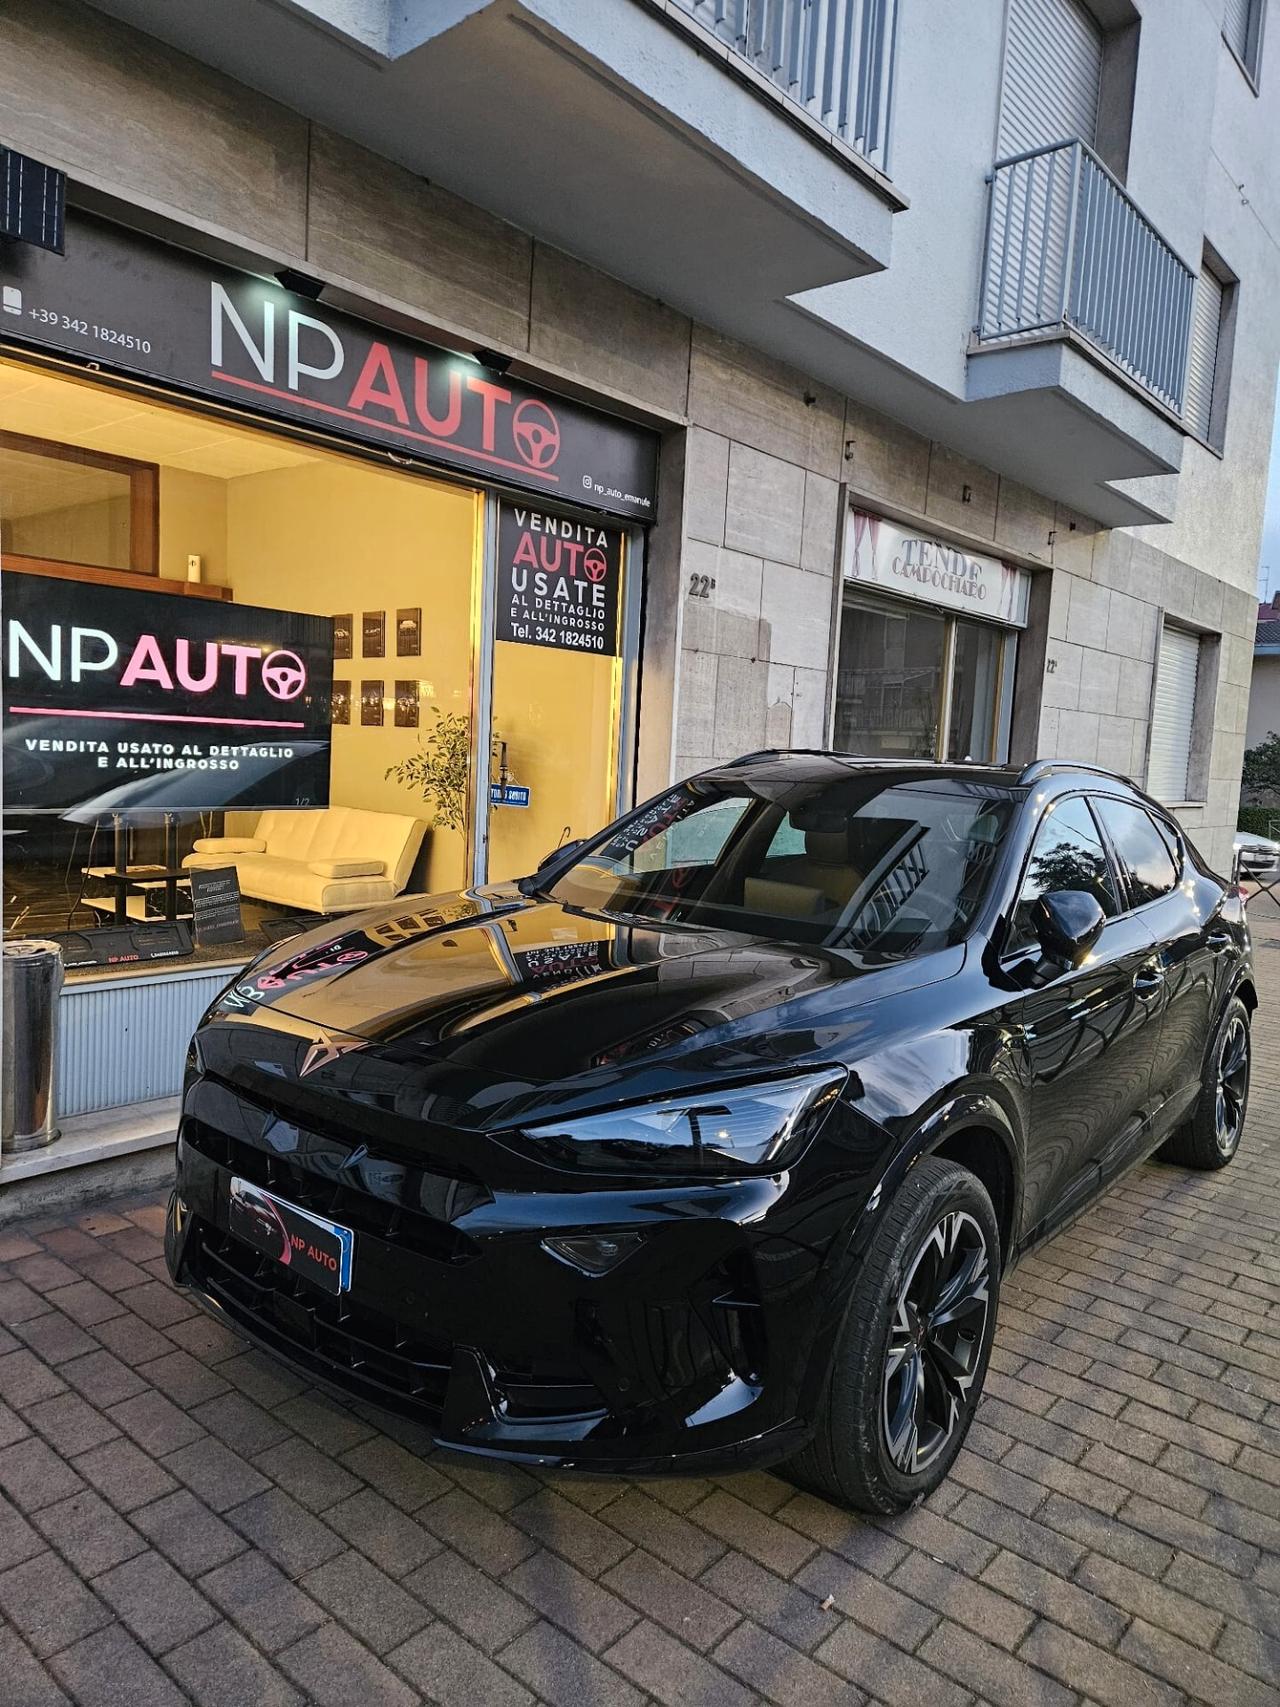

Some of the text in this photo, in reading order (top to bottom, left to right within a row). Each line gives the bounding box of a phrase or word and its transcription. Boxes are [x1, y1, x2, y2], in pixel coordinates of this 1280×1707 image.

[28, 308, 151, 354] +39 342 1824510
[514, 508, 608, 548] VENDITA
[512, 531, 607, 582] AUTO
[902, 539, 982, 581] TENDE
[511, 566, 606, 607] USATE
[510, 607, 605, 631] E ALL'INGROSSO
[511, 594, 605, 619] AL DETTAGLIO
[511, 622, 604, 650] Tel. 342 1824510
[25, 738, 294, 759] VENDITA USATO AL DETTAGLIO
[98, 756, 240, 770] E ALL'INGROSSO
[290, 1233, 337, 1272] NP AUTO
